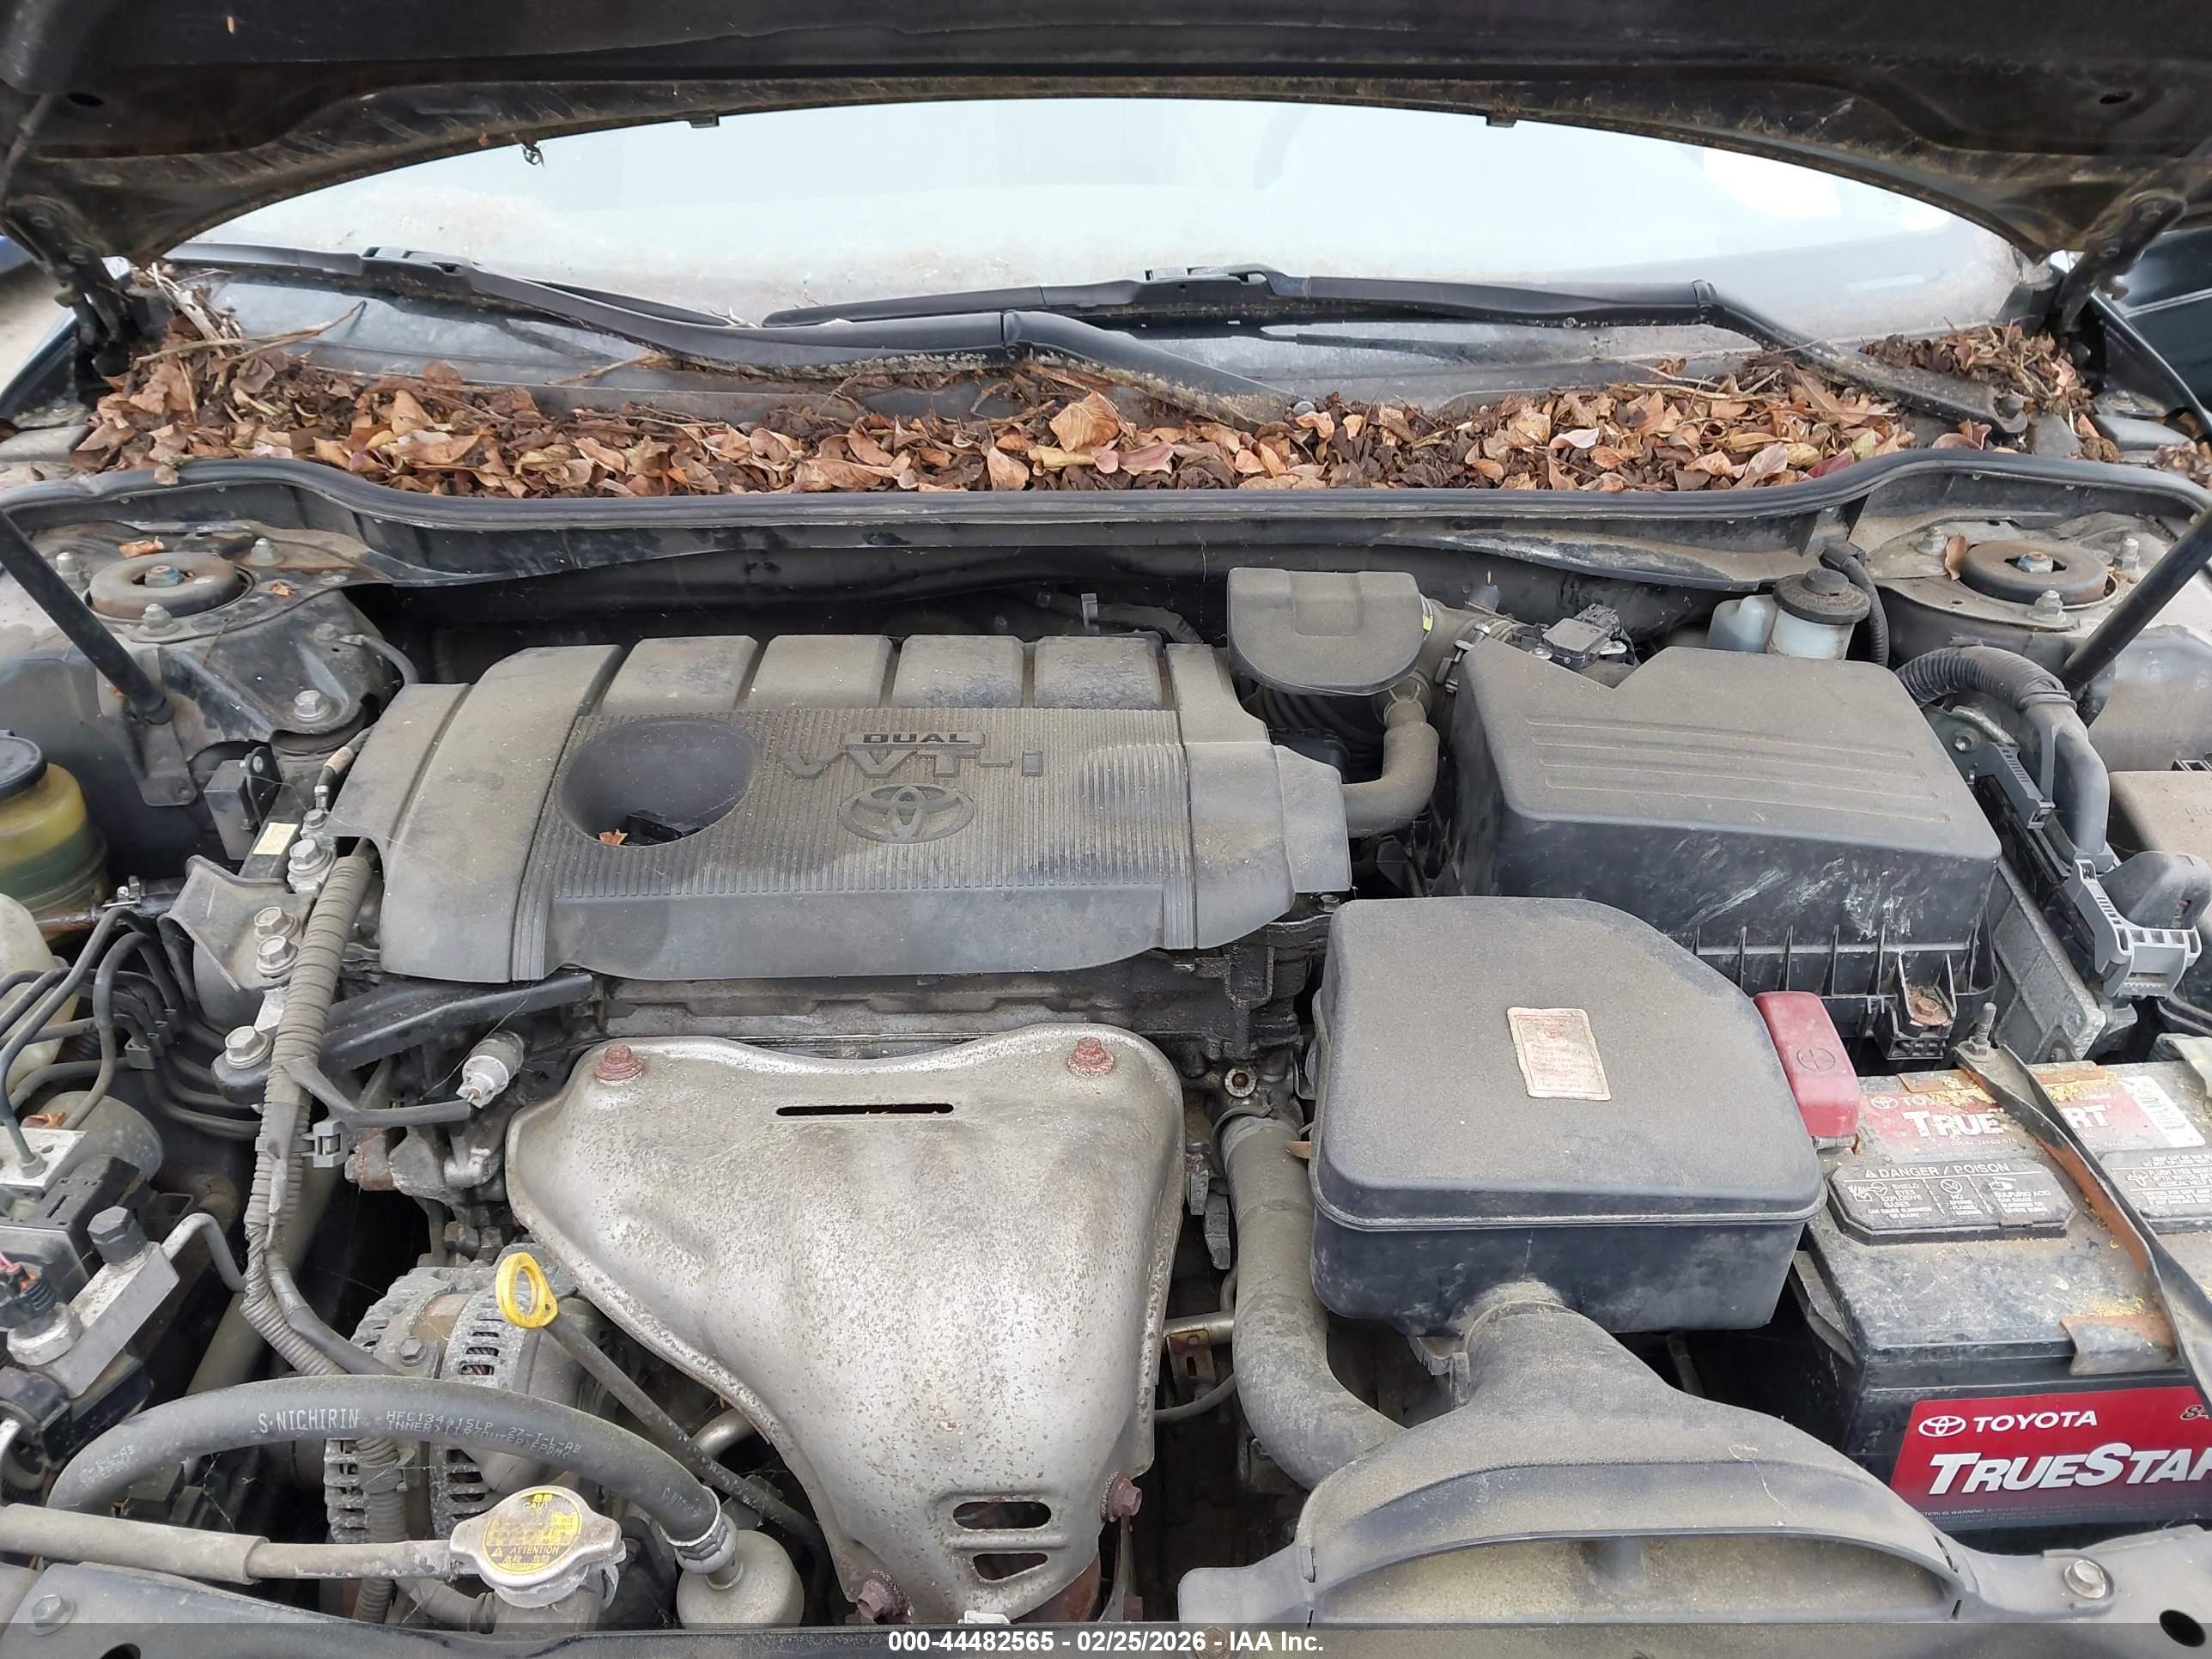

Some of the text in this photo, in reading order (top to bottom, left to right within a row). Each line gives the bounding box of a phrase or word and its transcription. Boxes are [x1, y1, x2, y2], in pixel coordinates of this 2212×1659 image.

[863, 732, 970, 744] DUAL
[1878, 1166, 1940, 1178] DANGER
[1953, 1163, 2011, 1175] POISON
[1972, 1410, 2098, 1433] TOYOTA
[509, 1546, 560, 1555] ATTENTION
